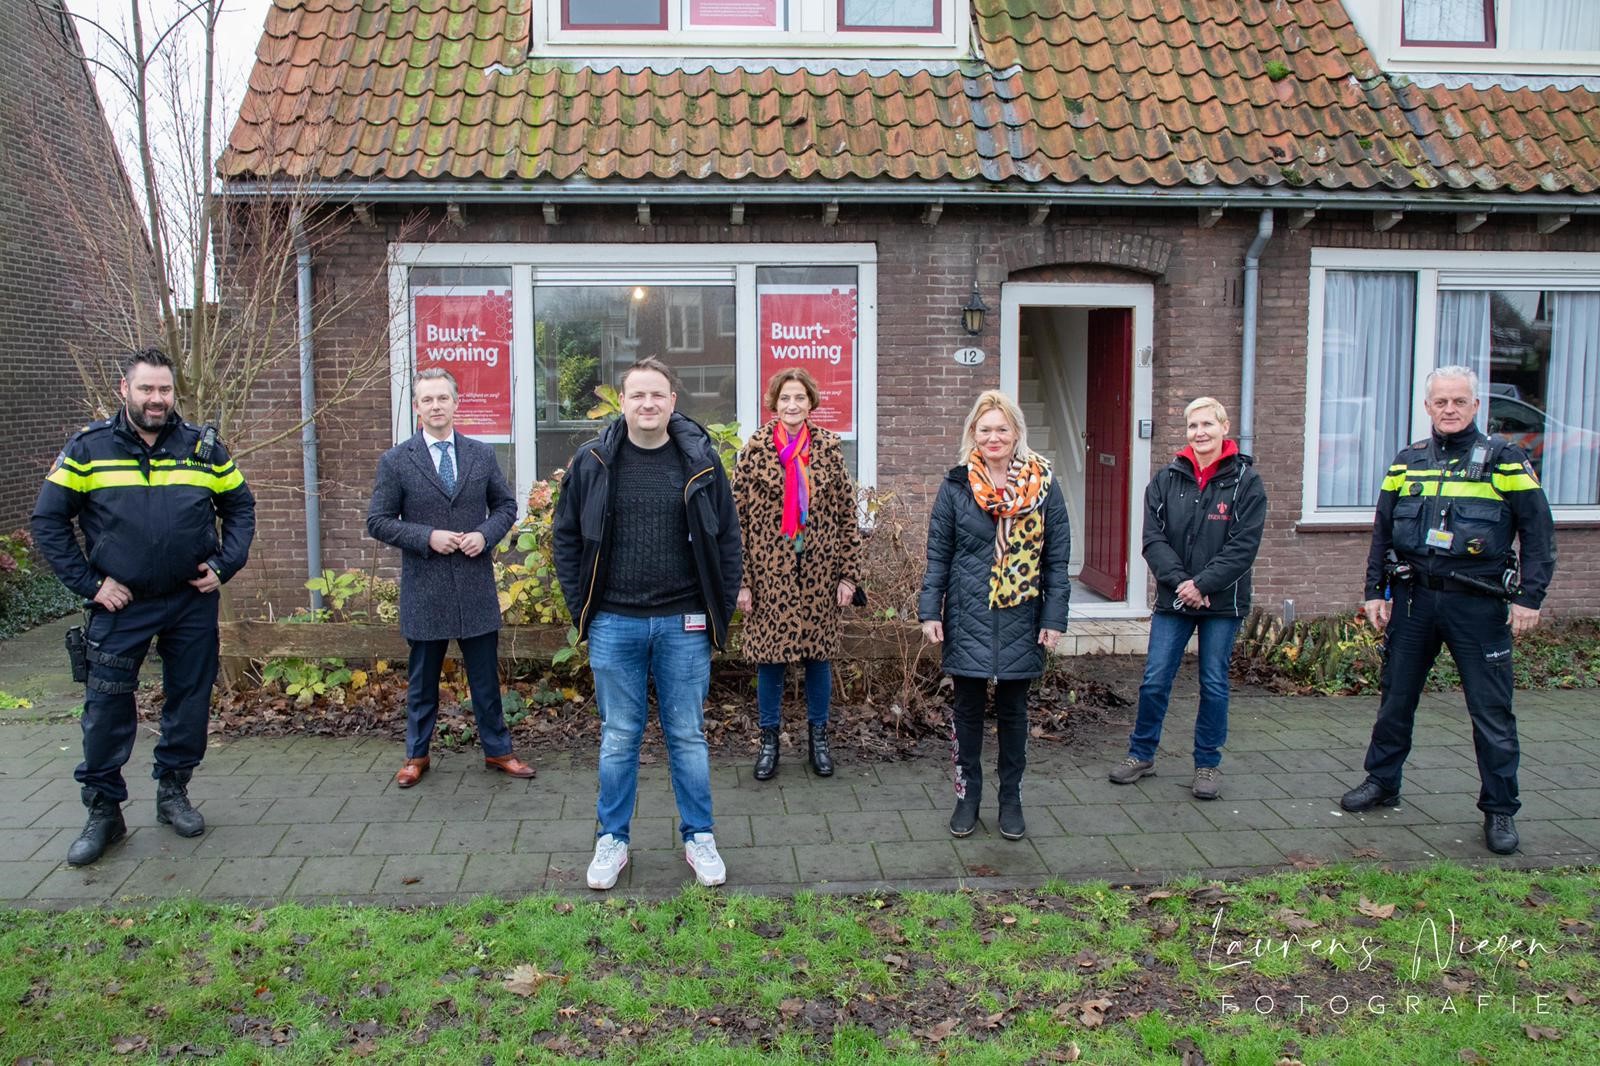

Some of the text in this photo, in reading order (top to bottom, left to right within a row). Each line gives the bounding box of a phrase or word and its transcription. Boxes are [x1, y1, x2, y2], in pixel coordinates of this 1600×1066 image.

[426, 324, 486, 342] Buurt-
[771, 322, 831, 340] Buurt-
[427, 342, 499, 367] woning
[771, 340, 842, 365] woning
[964, 350, 977, 363] 12
